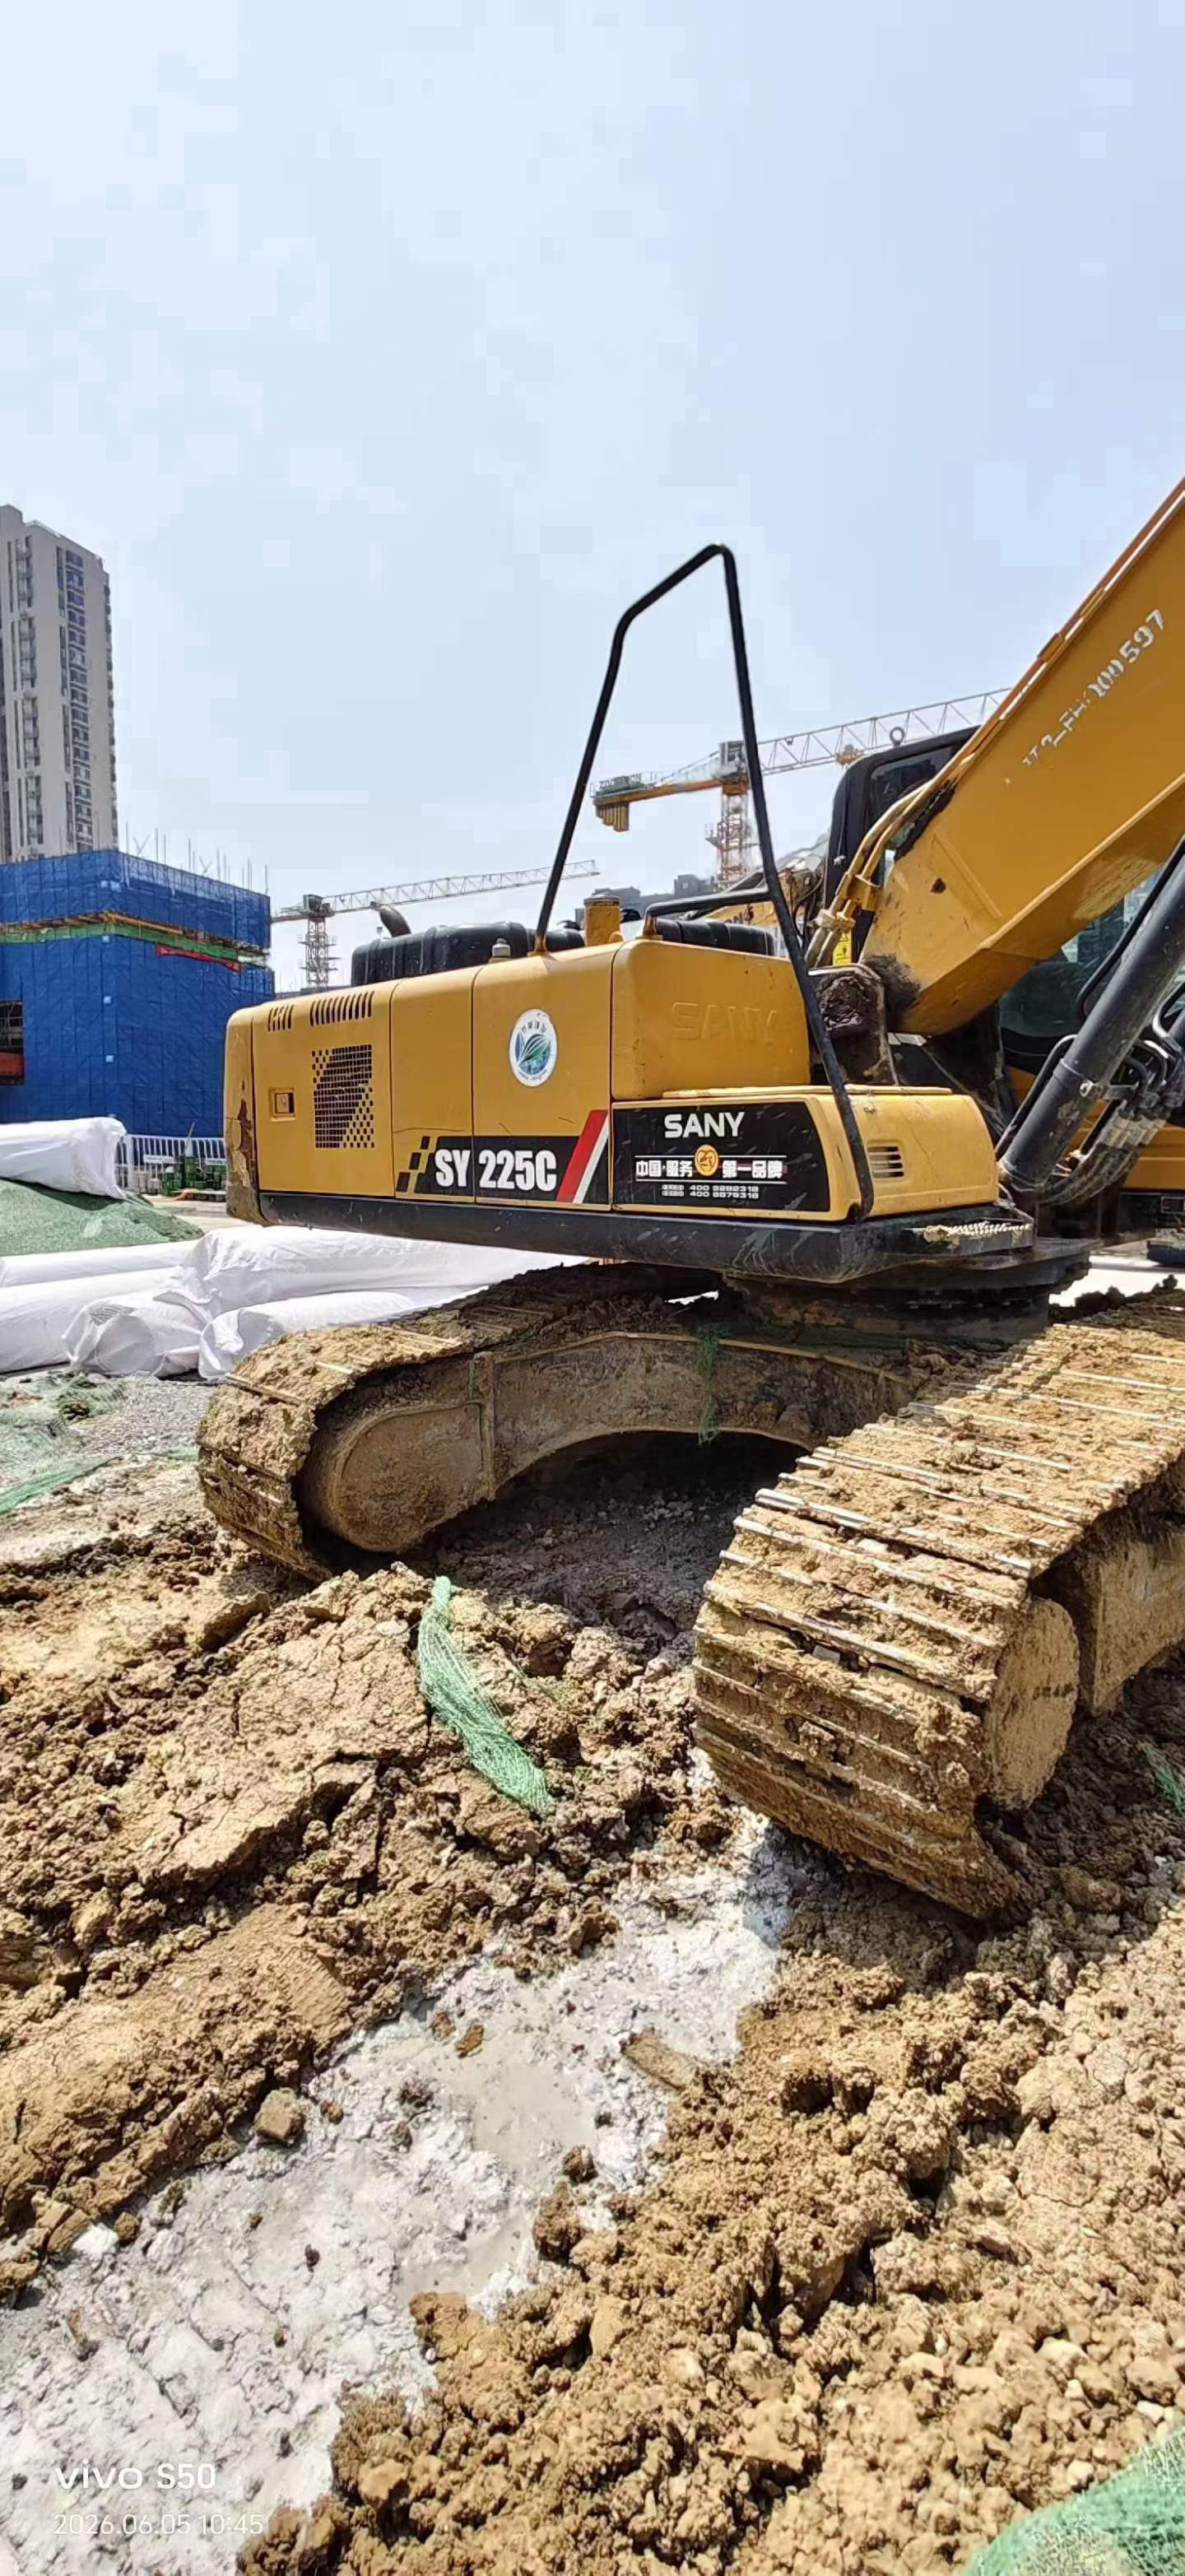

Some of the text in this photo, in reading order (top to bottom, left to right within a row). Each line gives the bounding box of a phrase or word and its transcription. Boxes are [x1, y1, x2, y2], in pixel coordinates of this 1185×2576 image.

[664, 1112, 745, 1138] SANY
[434, 1149, 557, 1192] SY 225C
[722, 1160, 783, 1179] 第一品牌
